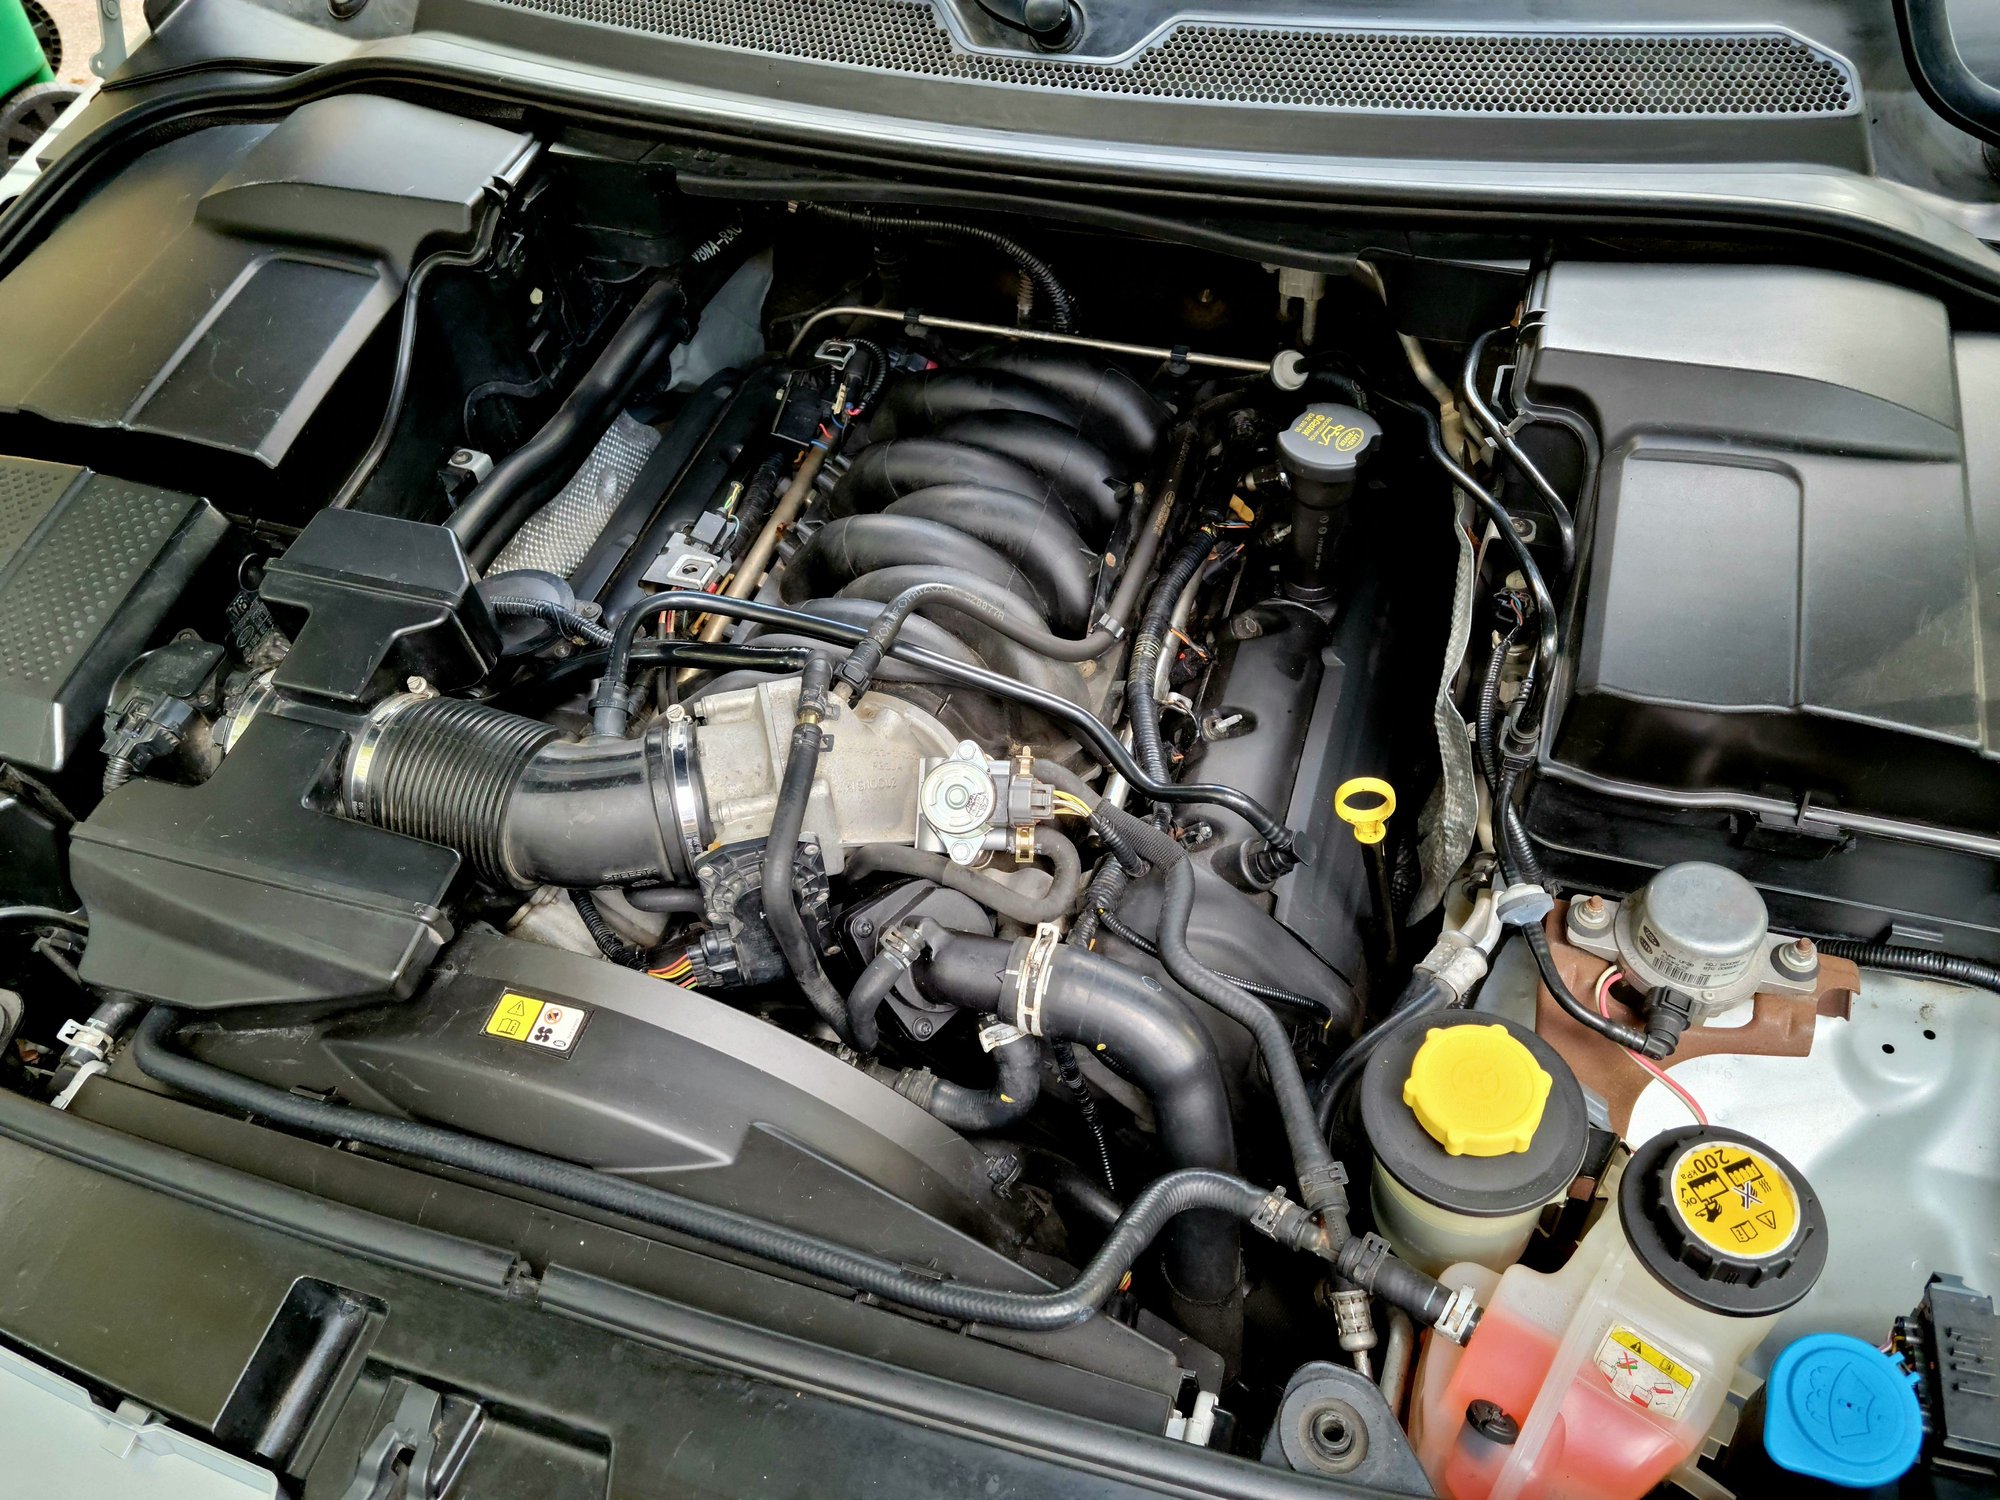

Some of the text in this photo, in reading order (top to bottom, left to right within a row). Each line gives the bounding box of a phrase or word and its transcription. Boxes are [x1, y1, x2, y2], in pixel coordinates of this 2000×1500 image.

[229, 595, 250, 619] V8
[1693, 1149, 1730, 1173] 200
[1680, 1169, 1698, 1180] kPa
[1683, 1197, 1698, 1208] OK
